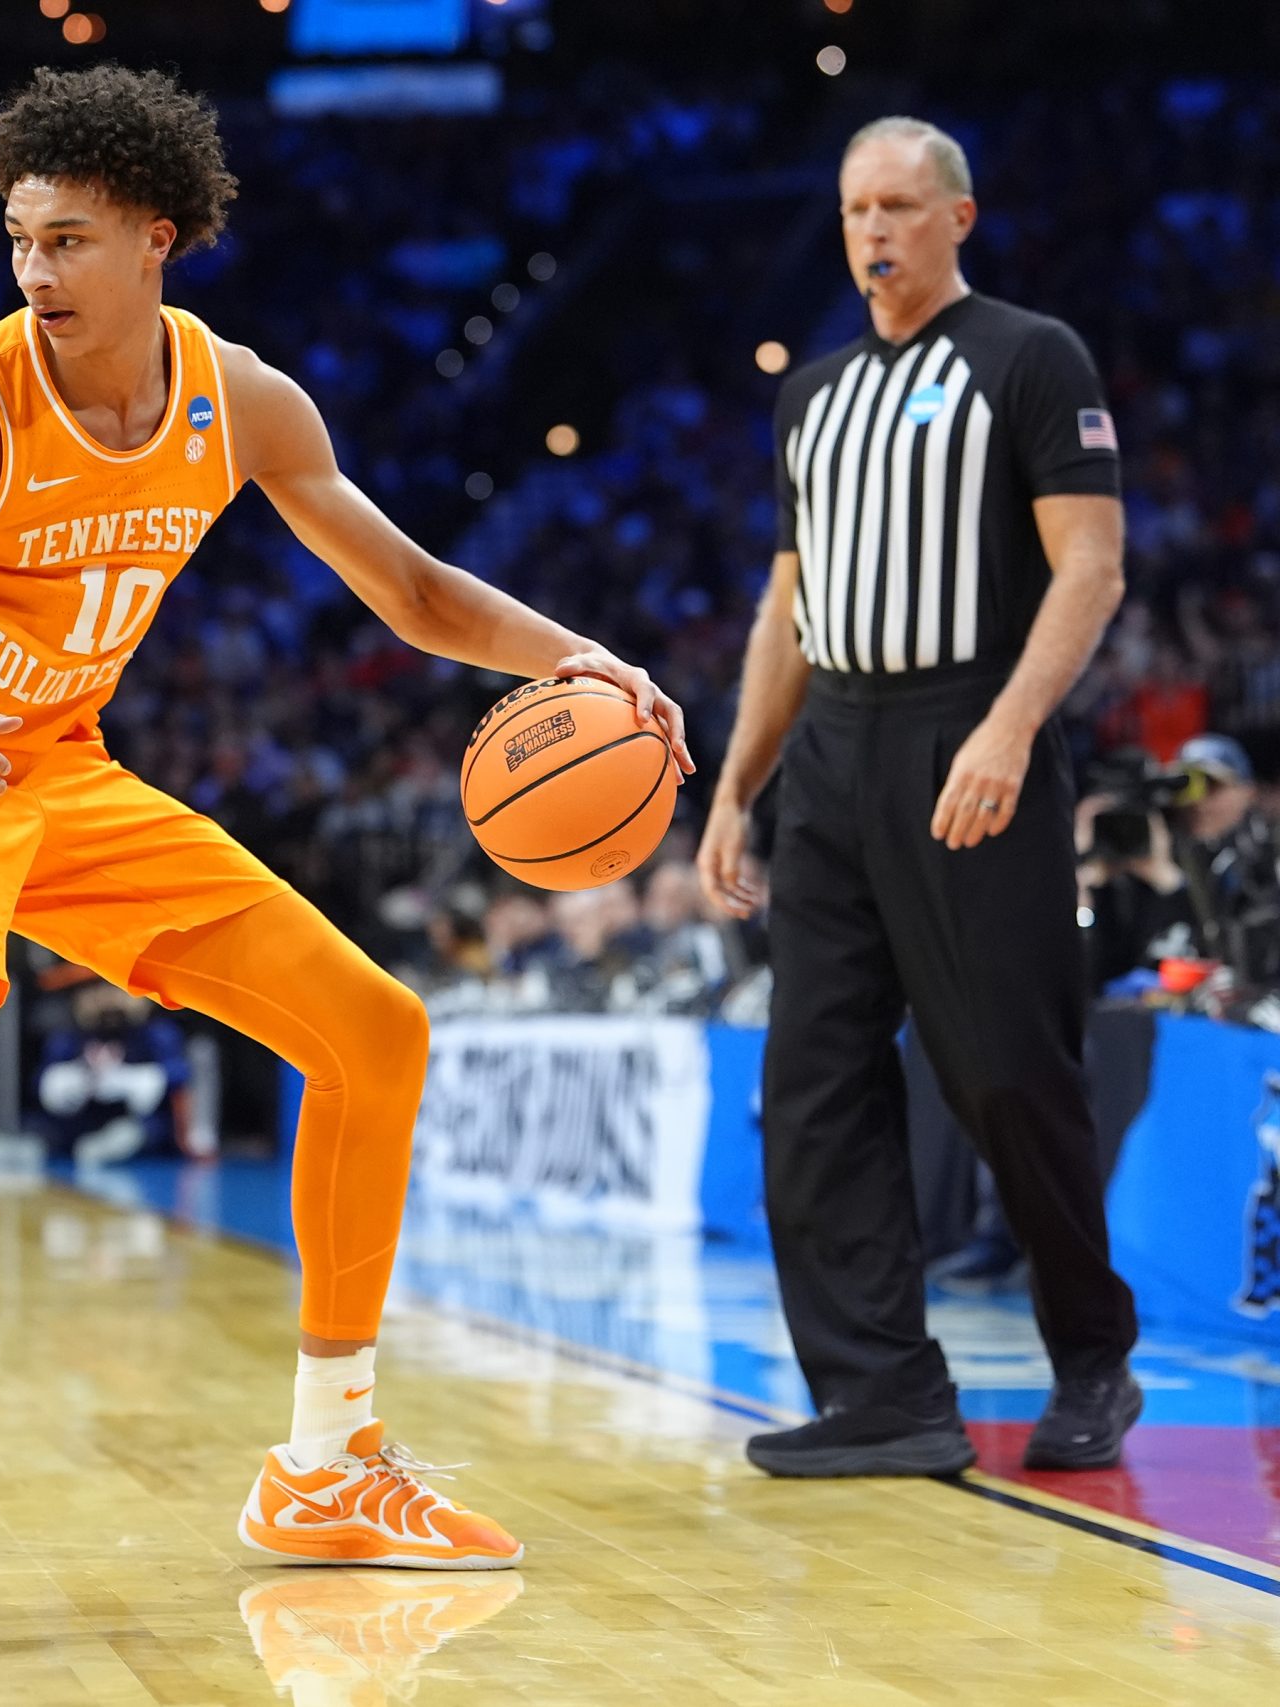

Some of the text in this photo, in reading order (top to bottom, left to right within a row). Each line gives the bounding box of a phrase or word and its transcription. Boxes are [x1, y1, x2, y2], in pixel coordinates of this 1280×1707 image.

[191, 410, 213, 423] NCAA
[62, 562, 166, 656] 10
[515, 719, 552, 747] MARCH
[523, 720, 575, 755] MADNESS
